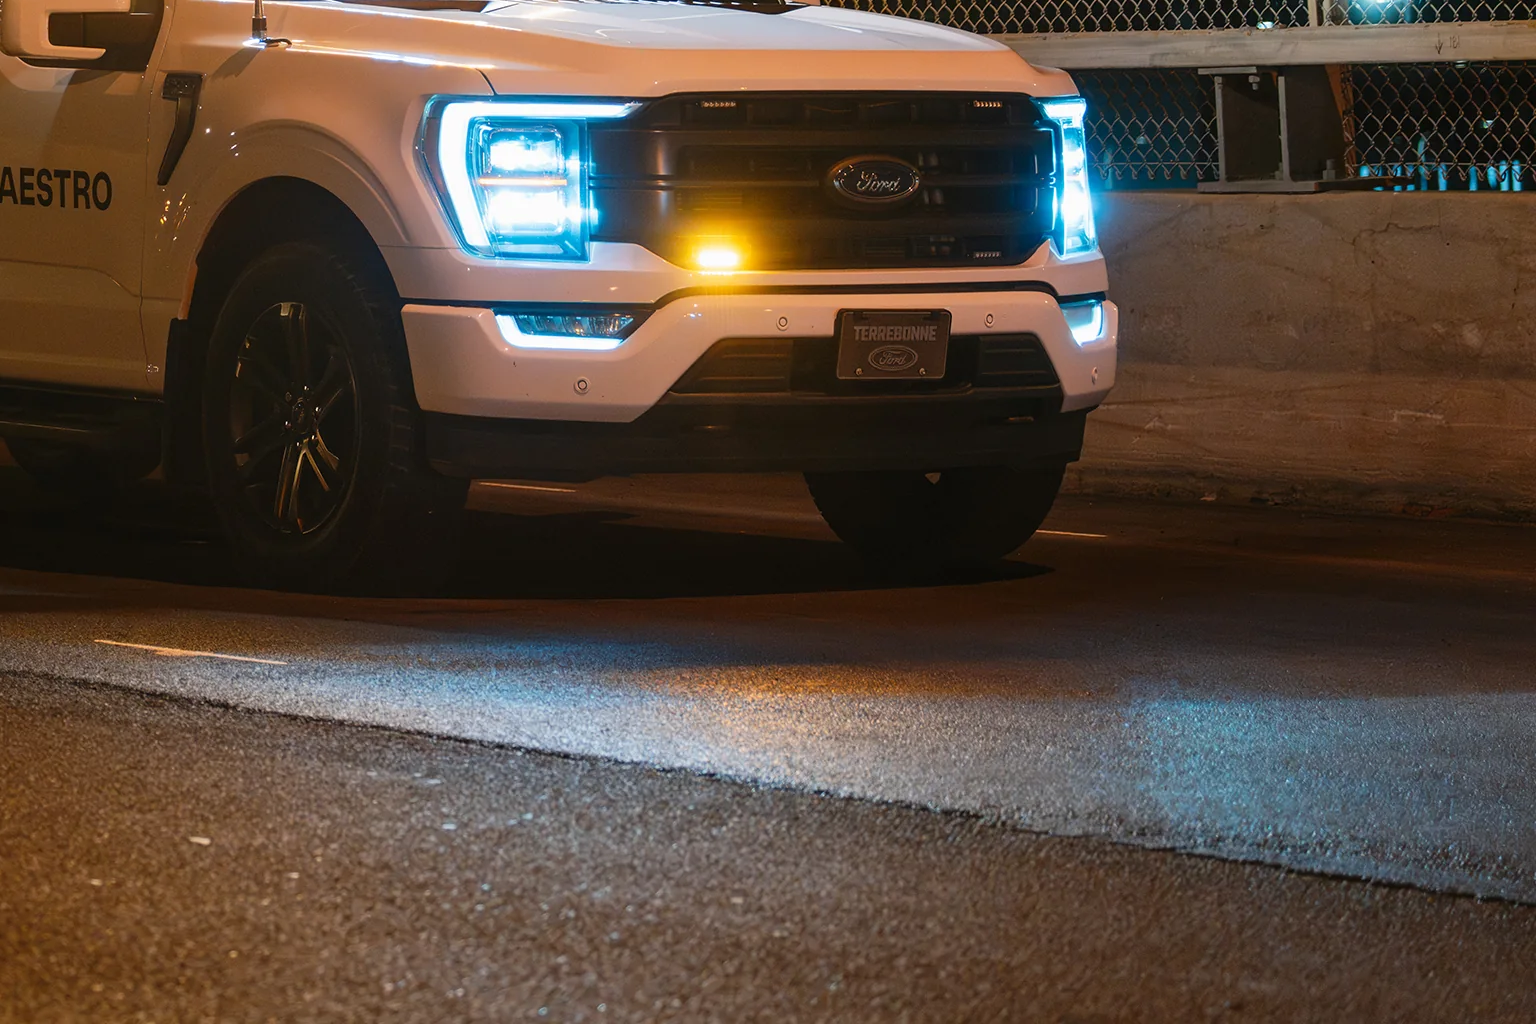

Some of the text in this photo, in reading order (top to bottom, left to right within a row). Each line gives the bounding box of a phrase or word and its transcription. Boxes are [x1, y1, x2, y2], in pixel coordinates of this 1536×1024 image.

[857, 171, 900, 192] Ford
[853, 325, 938, 342] TERREBONNE
[879, 350, 907, 366] Ford
